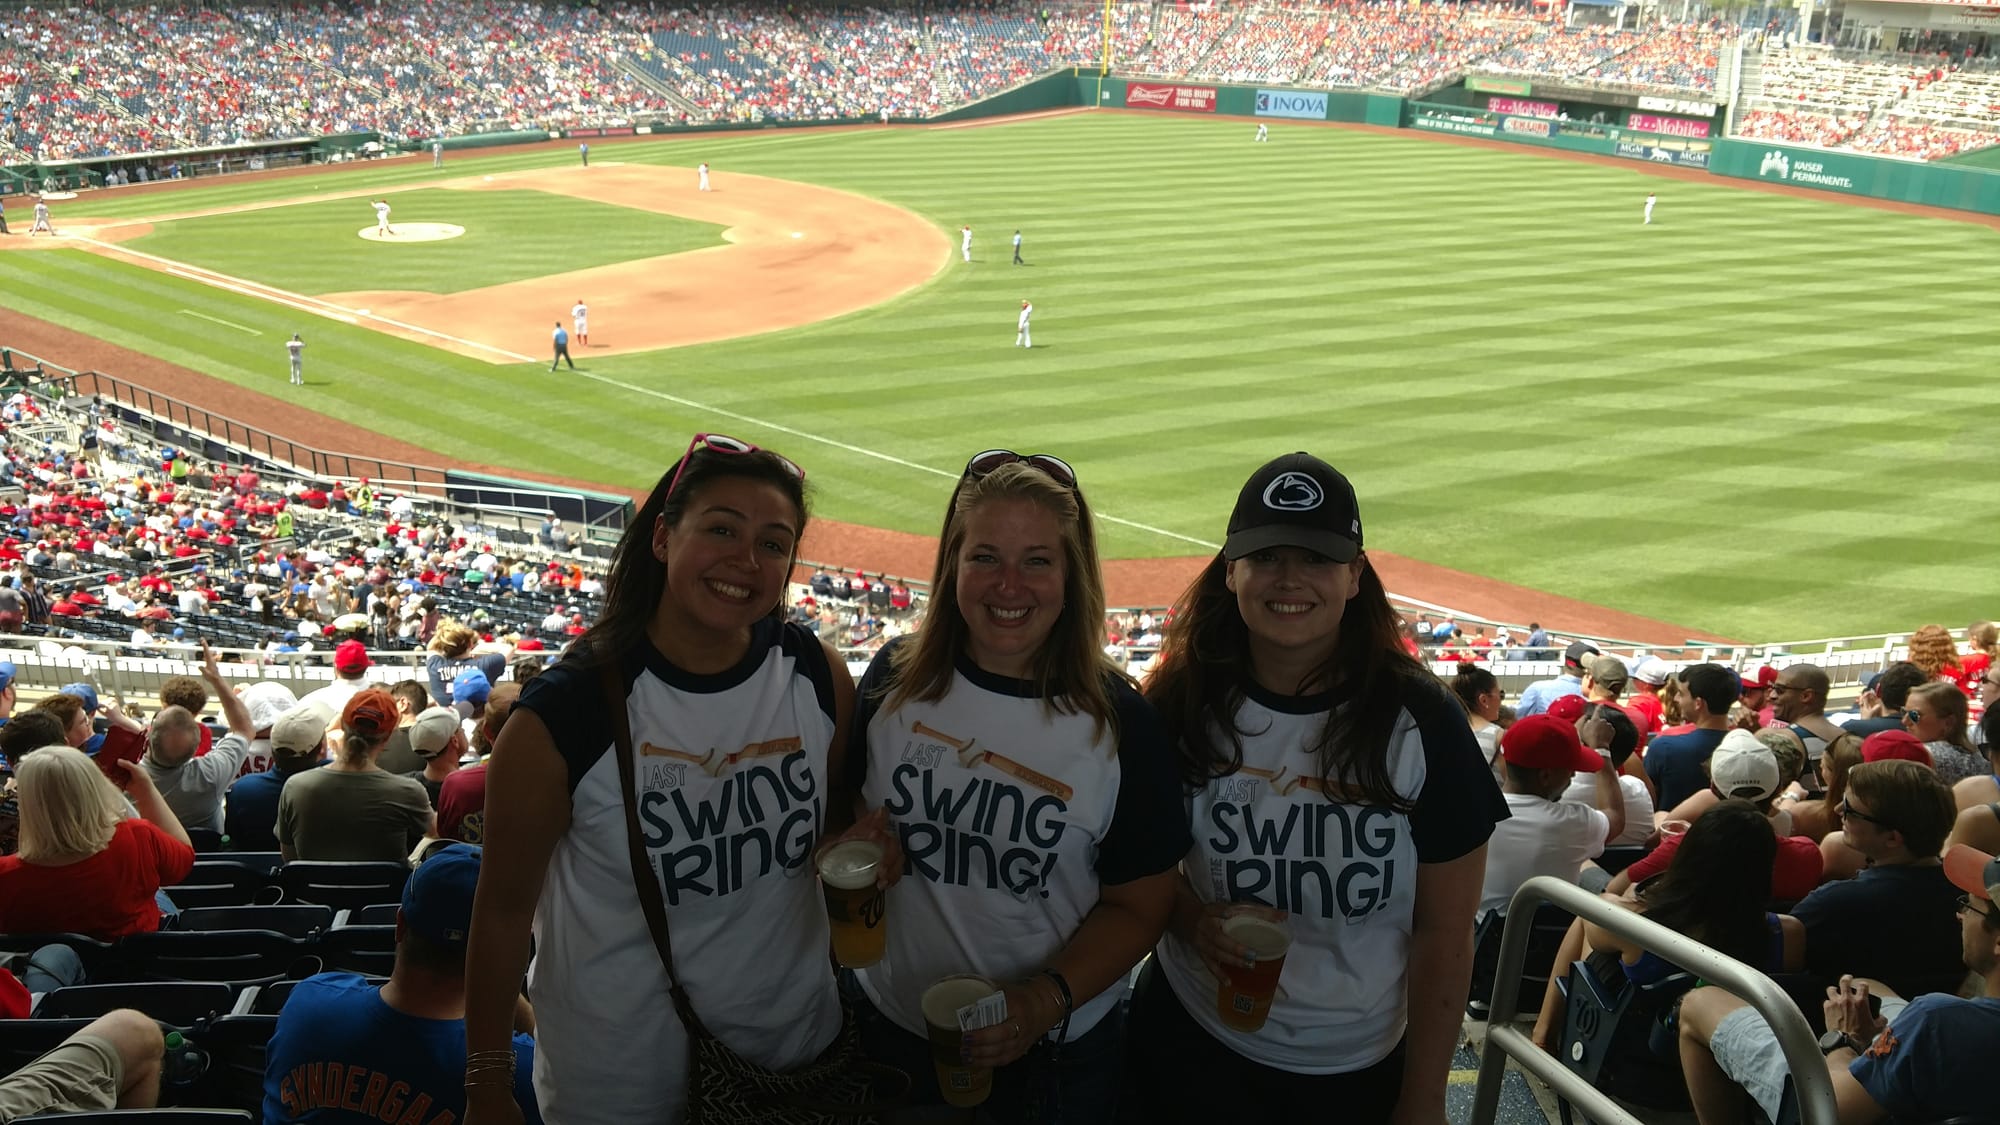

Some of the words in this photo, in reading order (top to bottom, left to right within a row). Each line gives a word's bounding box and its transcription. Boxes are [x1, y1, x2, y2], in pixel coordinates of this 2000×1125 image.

[1175, 88, 1192, 97] THIS
[1175, 98, 1190, 106] FOR
[1274, 96, 1324, 112] INOVA
[1620, 143, 1644, 153] MGM
[1680, 152, 1704, 162] MGM
[1794, 160, 1823, 172] KAISER
[901, 741, 946, 769] LAST
[642, 764, 687, 790] LAST
[1214, 777, 1259, 802] LAST
[640, 750, 816, 848] SWING
[885, 763, 1067, 849] SWING
[1210, 802, 1396, 858] SWING
[900, 822, 1058, 898] RING!
[1226, 858, 1394, 918] RING!
